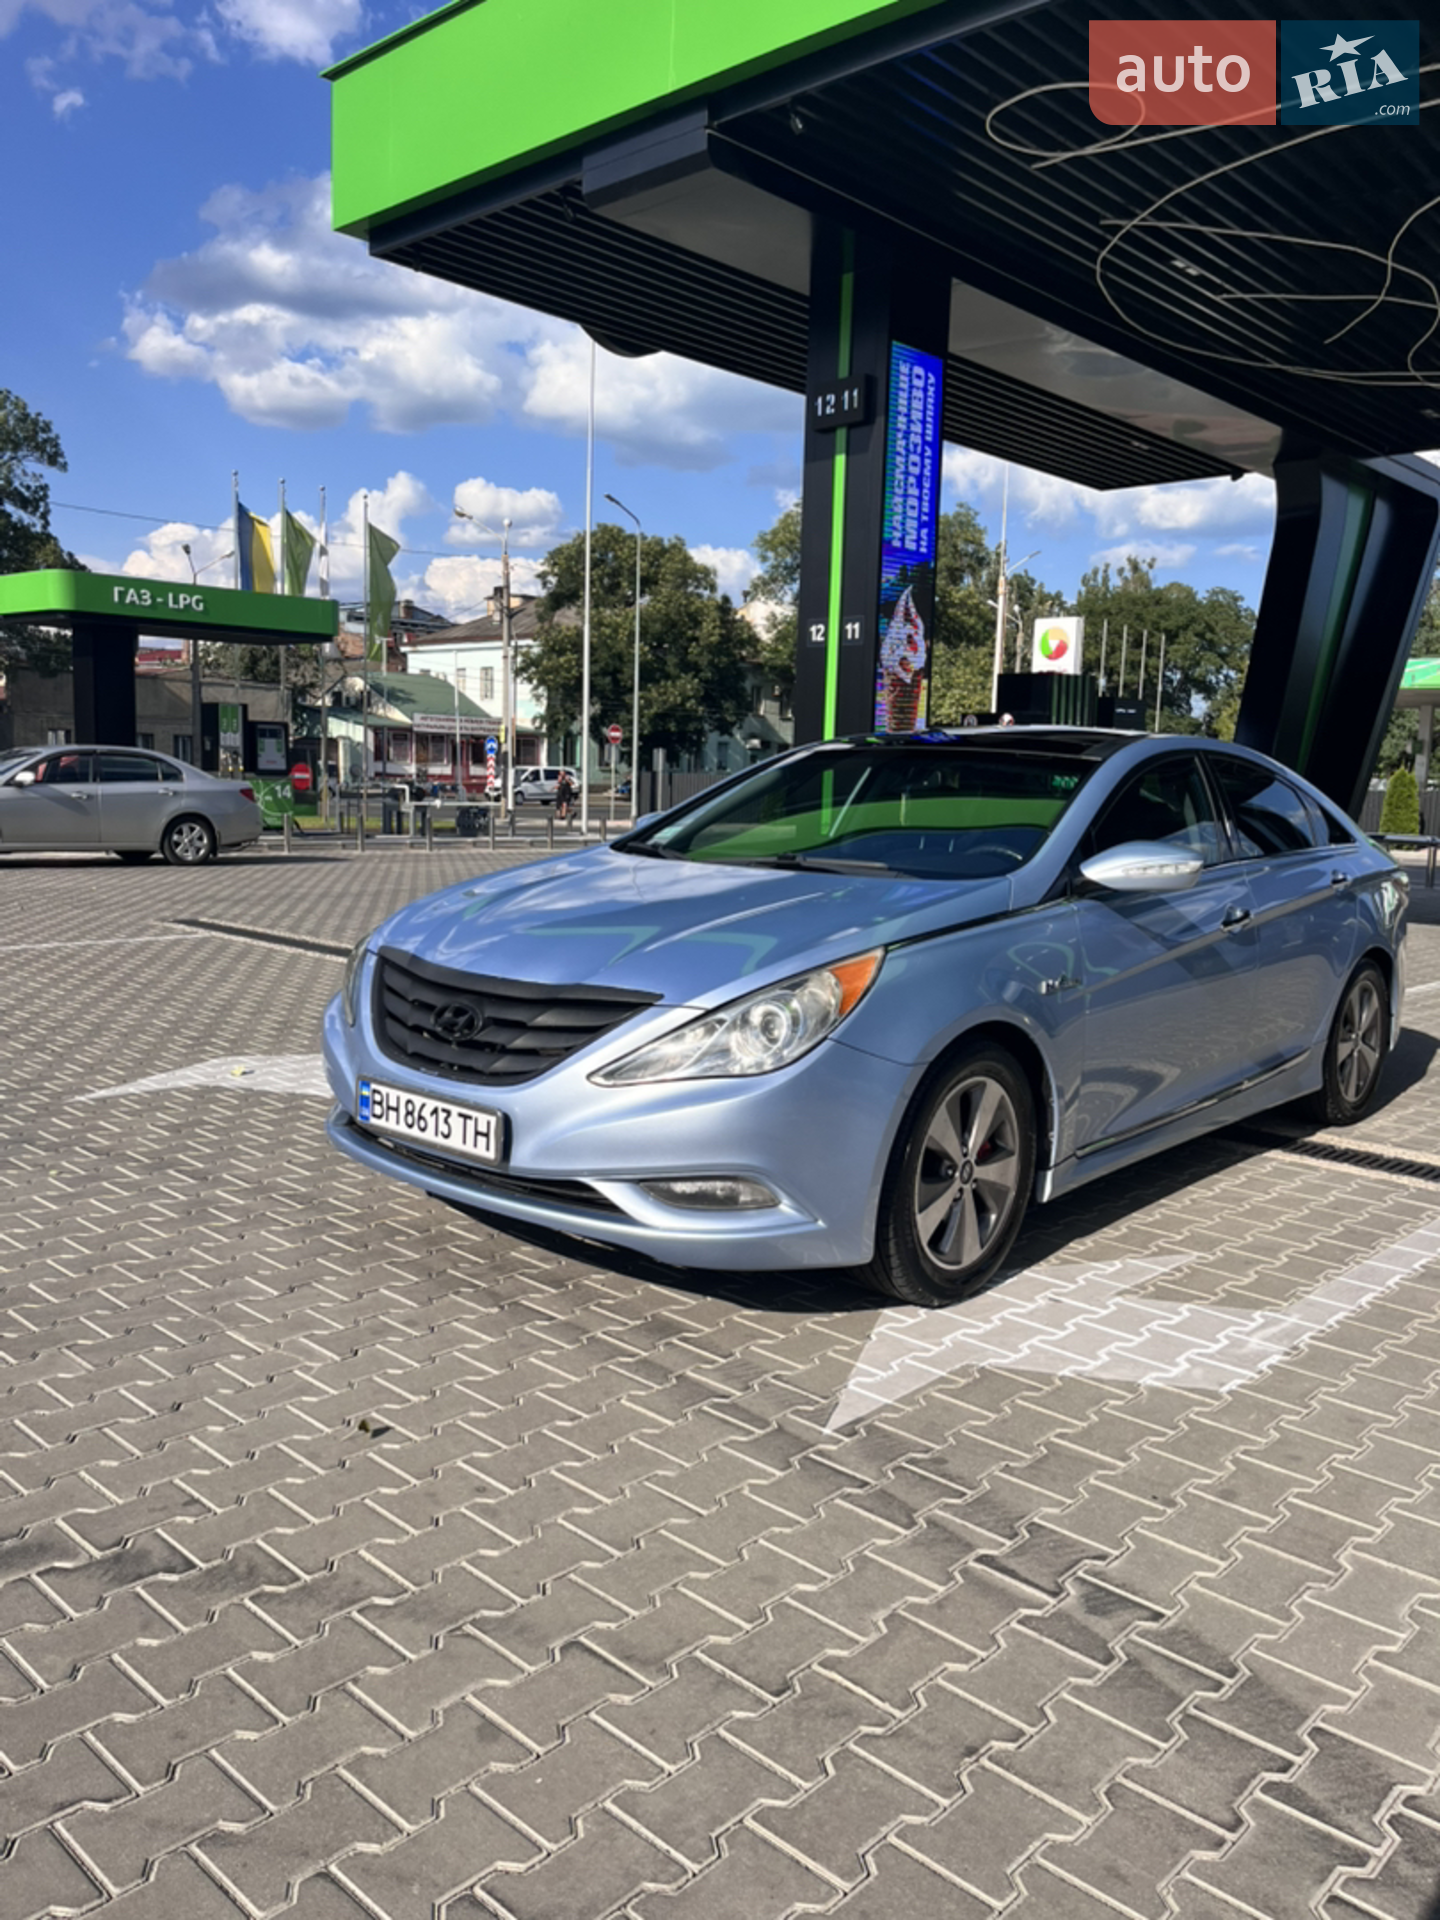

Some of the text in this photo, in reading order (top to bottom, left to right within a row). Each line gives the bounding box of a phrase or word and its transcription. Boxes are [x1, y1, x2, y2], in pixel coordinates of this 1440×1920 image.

[814, 387, 860, 417] 12 11
[904, 365, 925, 551] МОРОЗИВО
[919, 371, 936, 554] НА ТВОЄМУ ШЛЯХУ
[113, 586, 152, 606] ГАЗ
[168, 592, 204, 611] LPG
[809, 623, 826, 642] 12
[845, 622, 860, 640] 11
[275, 785, 292, 799] 14
[371, 1089, 491, 1152] BH 8613 TH
